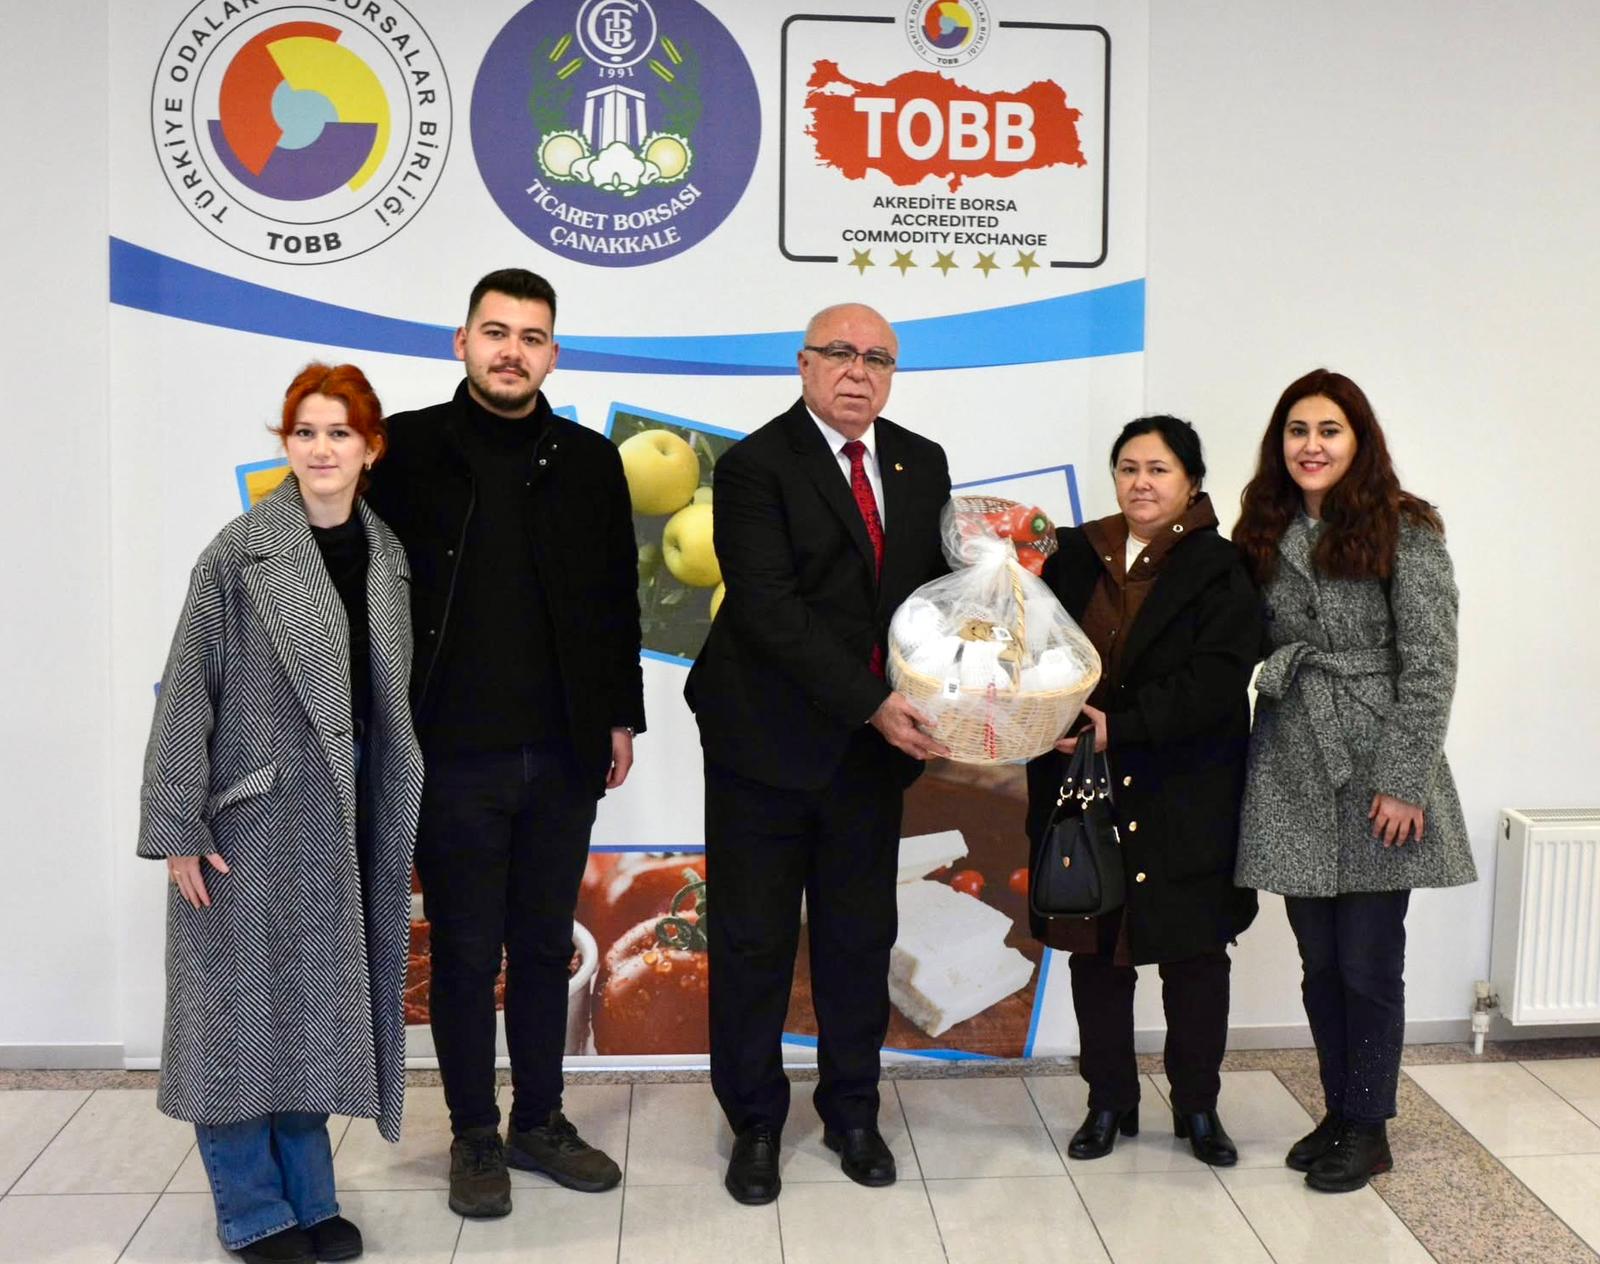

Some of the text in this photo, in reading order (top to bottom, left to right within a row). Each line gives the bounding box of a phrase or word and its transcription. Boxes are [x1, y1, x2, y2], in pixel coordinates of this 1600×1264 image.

[325, 0, 436, 106] ORSALAR
[599, 66, 634, 79] 1991
[854, 97, 1036, 162] TOBB
[165, 98, 228, 223] TÜRKİYE
[374, 121, 439, 227] BİRLİĞİ
[525, 178, 702, 231] TİCARET BORSASI
[873, 193, 1017, 212] AKREDİTE BORSA
[891, 213, 999, 228] ACCREDITED
[266, 231, 342, 254] TOBB
[549, 226, 681, 254] ÇANAKKALE
[842, 229, 1047, 247] COMMODITY EXCHANGE
